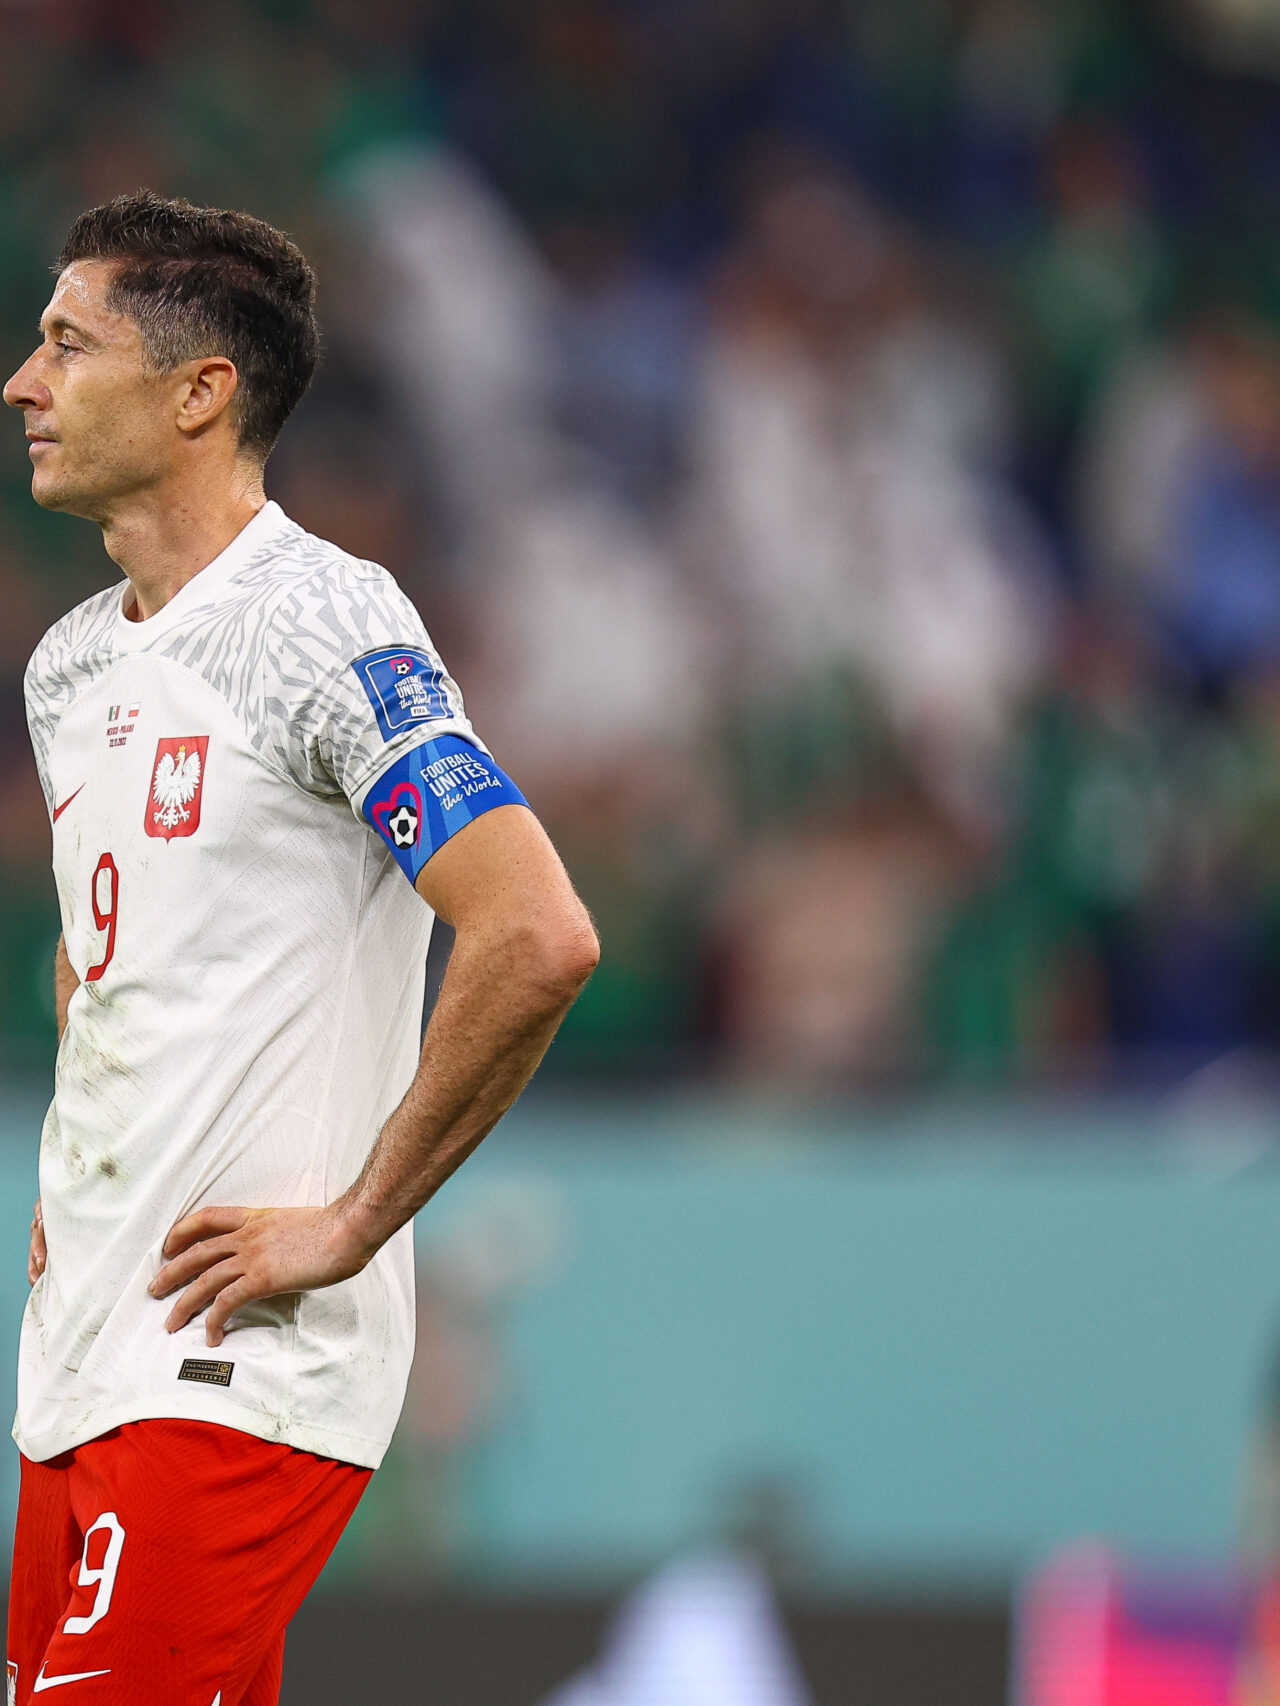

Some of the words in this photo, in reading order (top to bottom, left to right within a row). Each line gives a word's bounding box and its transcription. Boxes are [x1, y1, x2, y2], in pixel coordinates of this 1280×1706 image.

[399, 698, 412, 709] the
[420, 752, 477, 783] FOOTBALL
[428, 762, 489, 797] UNITES
[440, 793, 463, 811] the
[461, 775, 502, 797] World
[84, 852, 119, 982] 9
[62, 1511, 126, 1634] 9
